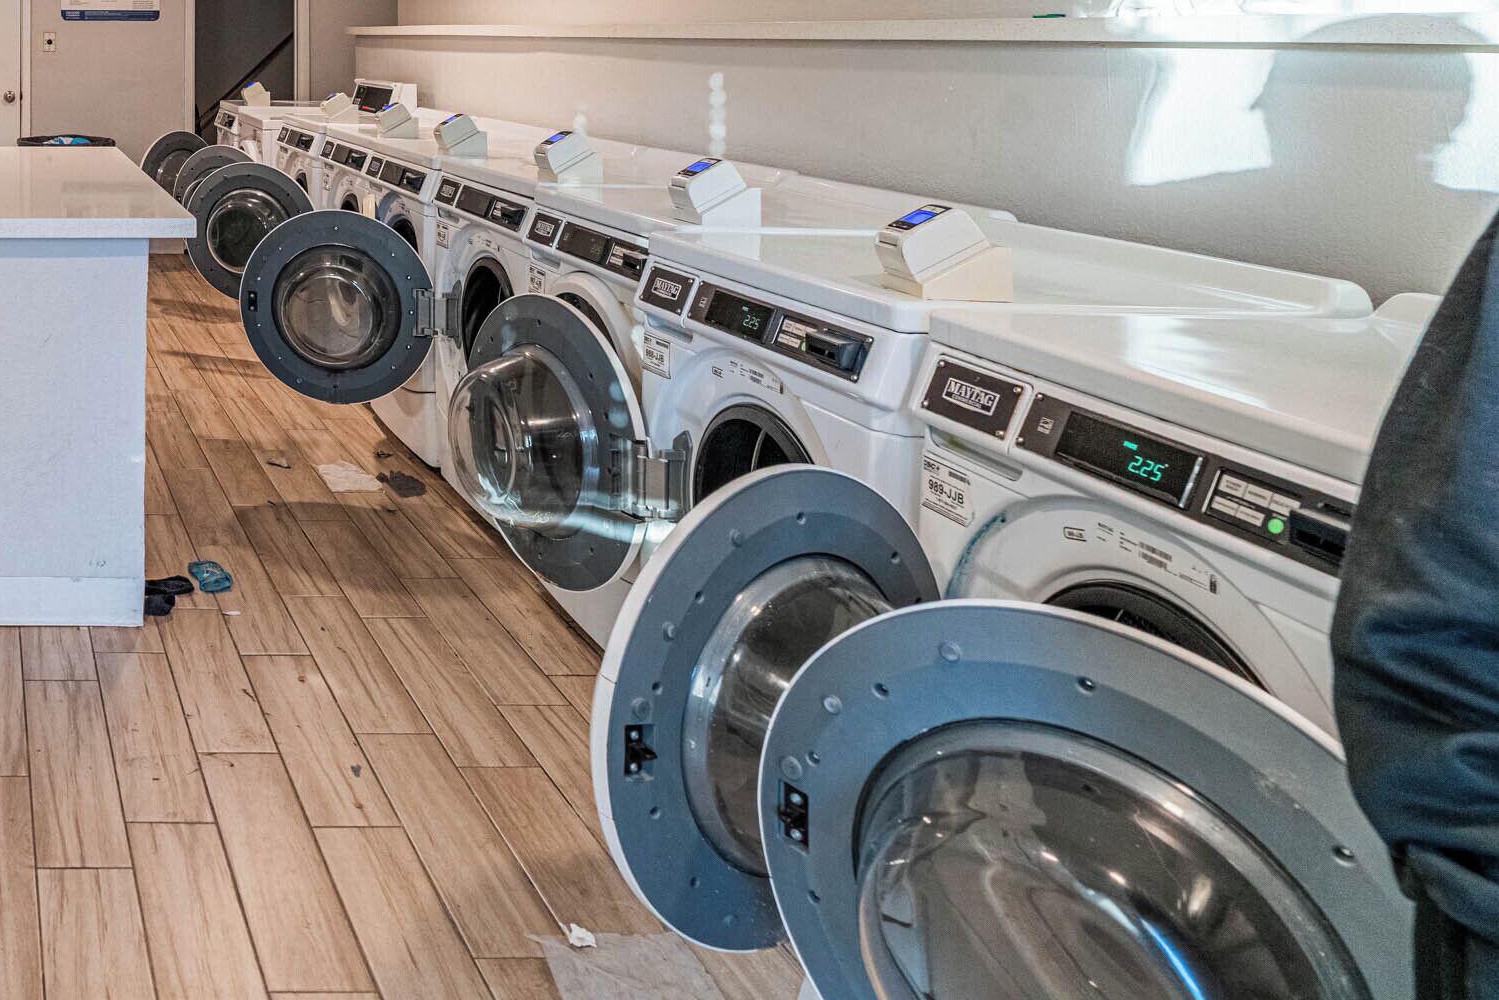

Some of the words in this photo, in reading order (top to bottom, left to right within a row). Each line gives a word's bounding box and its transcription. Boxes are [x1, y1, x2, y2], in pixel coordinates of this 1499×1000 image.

[655, 279, 680, 295] MAYTAG
[947, 380, 995, 408] MAYTAG
[1127, 454, 1163, 482] 2.25
[928, 479, 965, 505] 989-JJB
